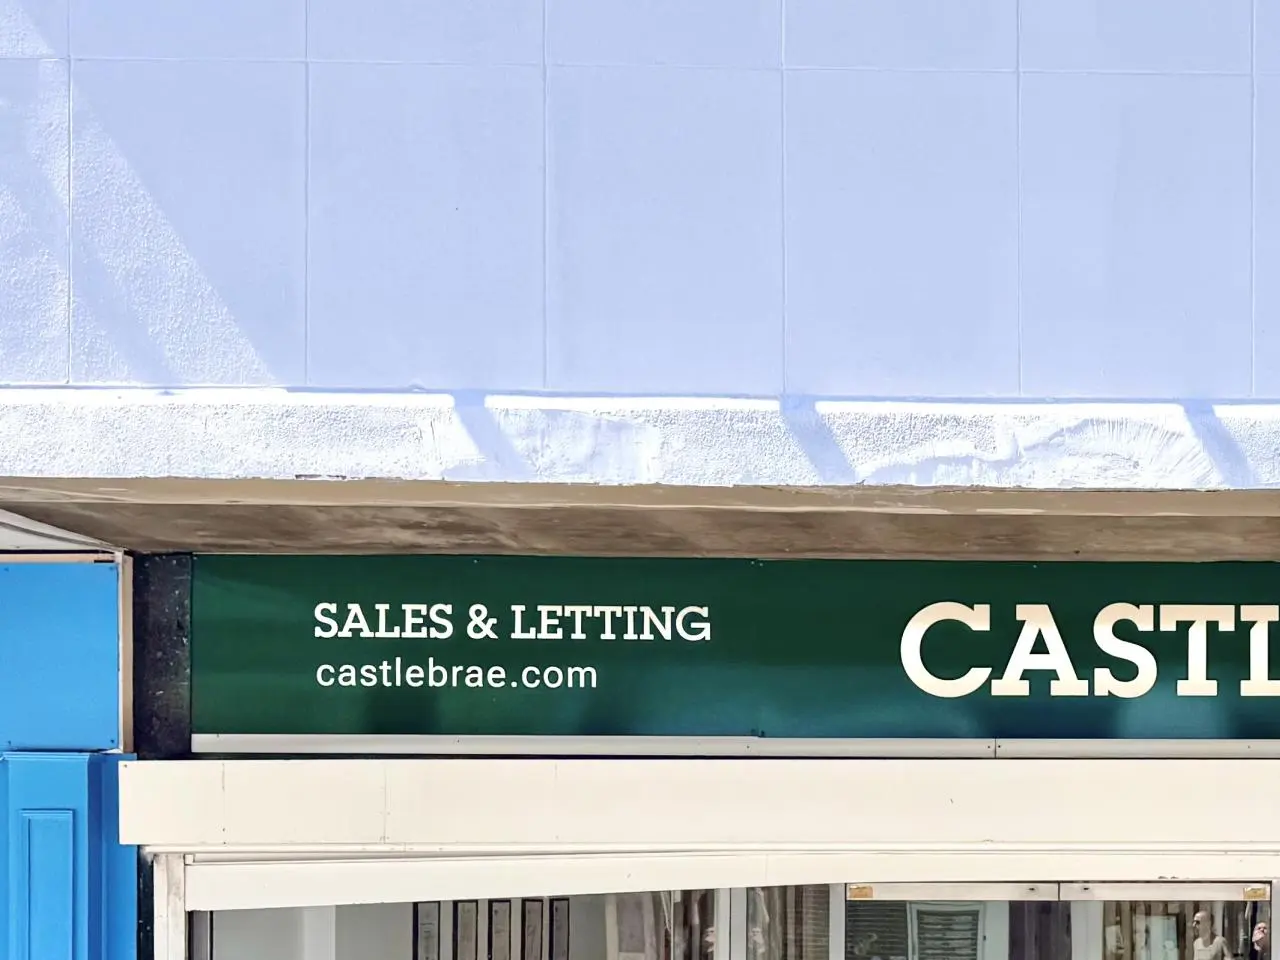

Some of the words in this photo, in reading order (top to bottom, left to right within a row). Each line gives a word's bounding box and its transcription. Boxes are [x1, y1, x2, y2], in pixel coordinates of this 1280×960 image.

[314, 602, 454, 639] SALES
[466, 603, 499, 640] &
[510, 604, 711, 641] LETTING
[316, 656, 598, 689] castlebrae.com
